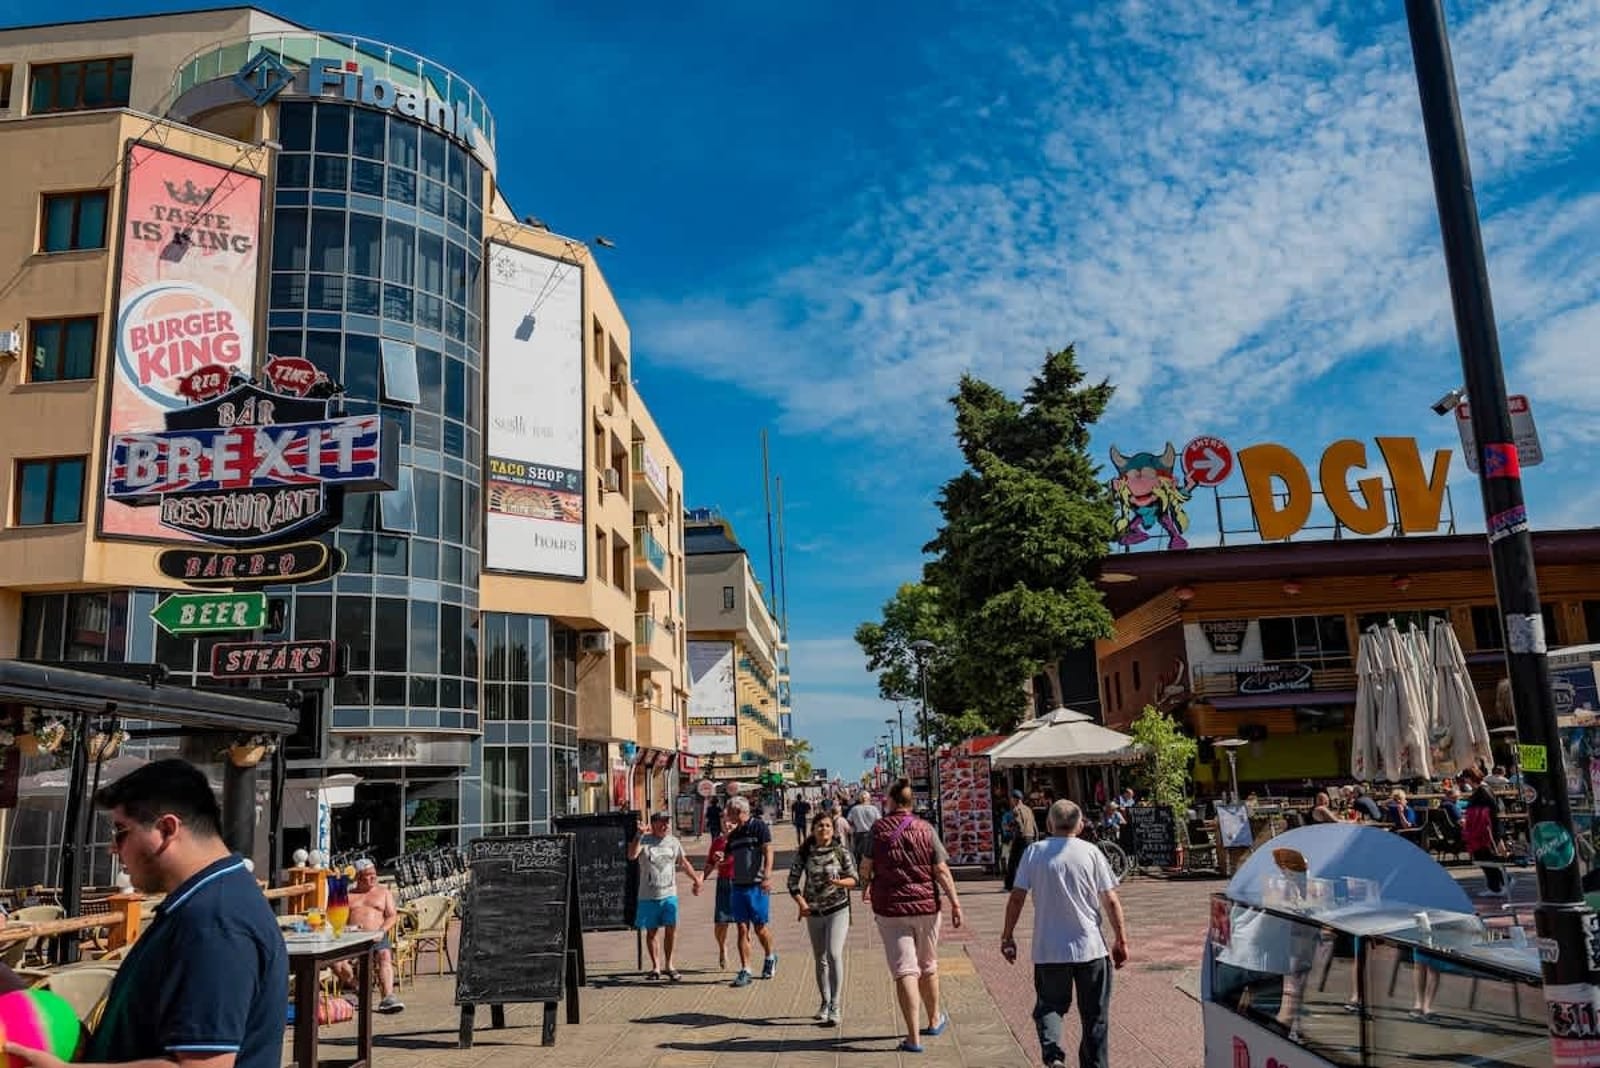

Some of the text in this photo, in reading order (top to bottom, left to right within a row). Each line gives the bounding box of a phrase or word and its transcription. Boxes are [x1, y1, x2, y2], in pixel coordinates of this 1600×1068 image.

[309, 57, 482, 148] Fibank
[131, 221, 162, 242] IS
[151, 204, 231, 231] TASTE
[129, 310, 234, 353] BURGER
[137, 332, 242, 386] KING
[191, 372, 221, 392] RIB
[275, 364, 313, 385] TIME
[217, 396, 276, 427] BAR
[125, 426, 365, 488] BREXIT
[489, 459, 525, 478] TACO
[528, 466, 565, 482] SHOP
[1237, 436, 1453, 542] DGV
[161, 488, 320, 533] RESTAURANT
[533, 532, 577, 552] hours
[179, 600, 249, 627] BEER
[225, 645, 323, 673] STEAKS
